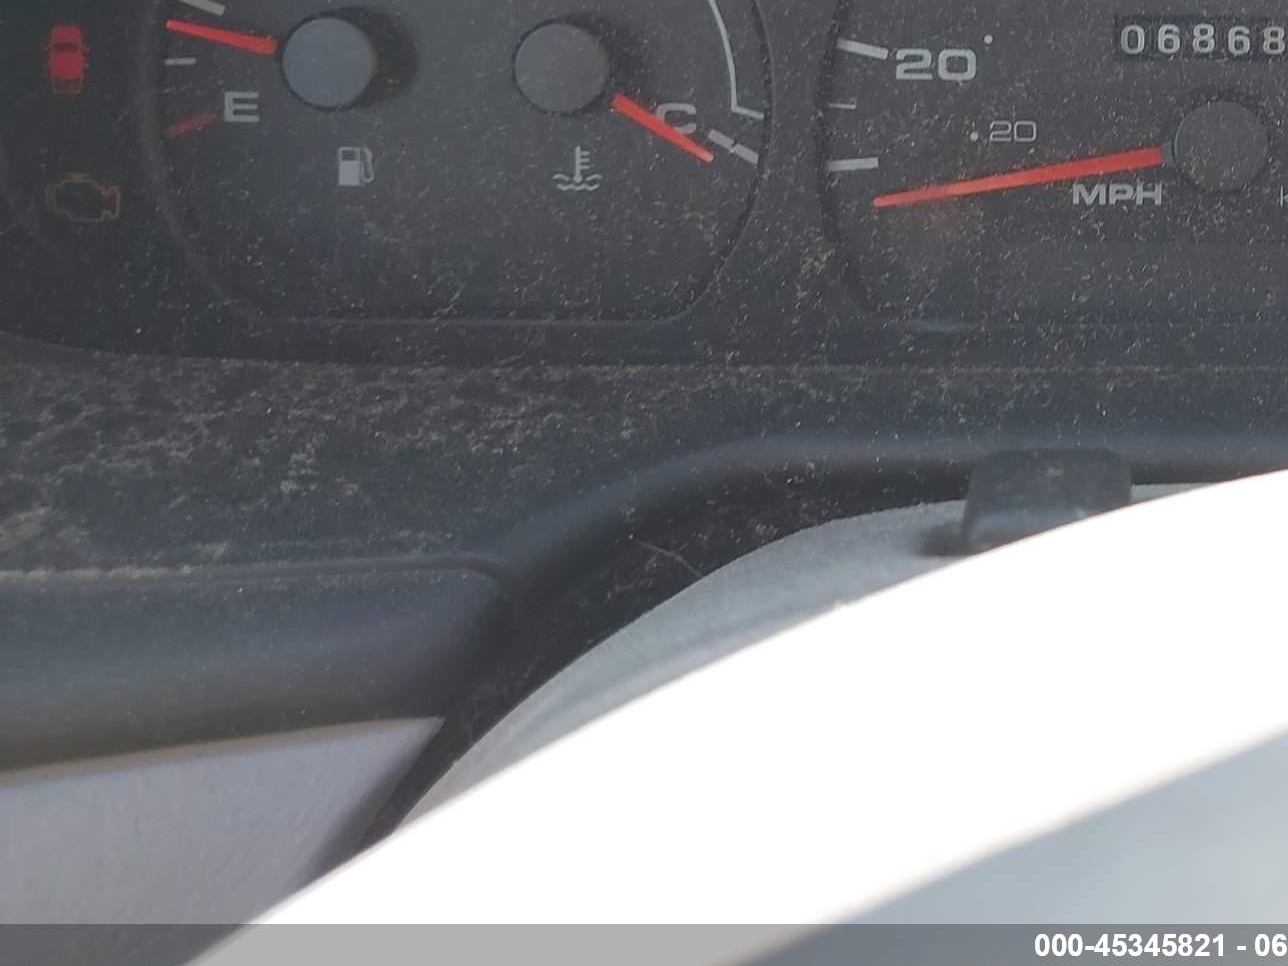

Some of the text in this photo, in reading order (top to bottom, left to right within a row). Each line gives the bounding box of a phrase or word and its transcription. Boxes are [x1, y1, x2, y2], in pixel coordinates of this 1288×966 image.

[895, 48, 977, 82] 20
[223, 91, 260, 123] E
[655, 102, 697, 135] C
[989, 120, 1037, 142] 20
[1072, 181, 1162, 206] MPH
